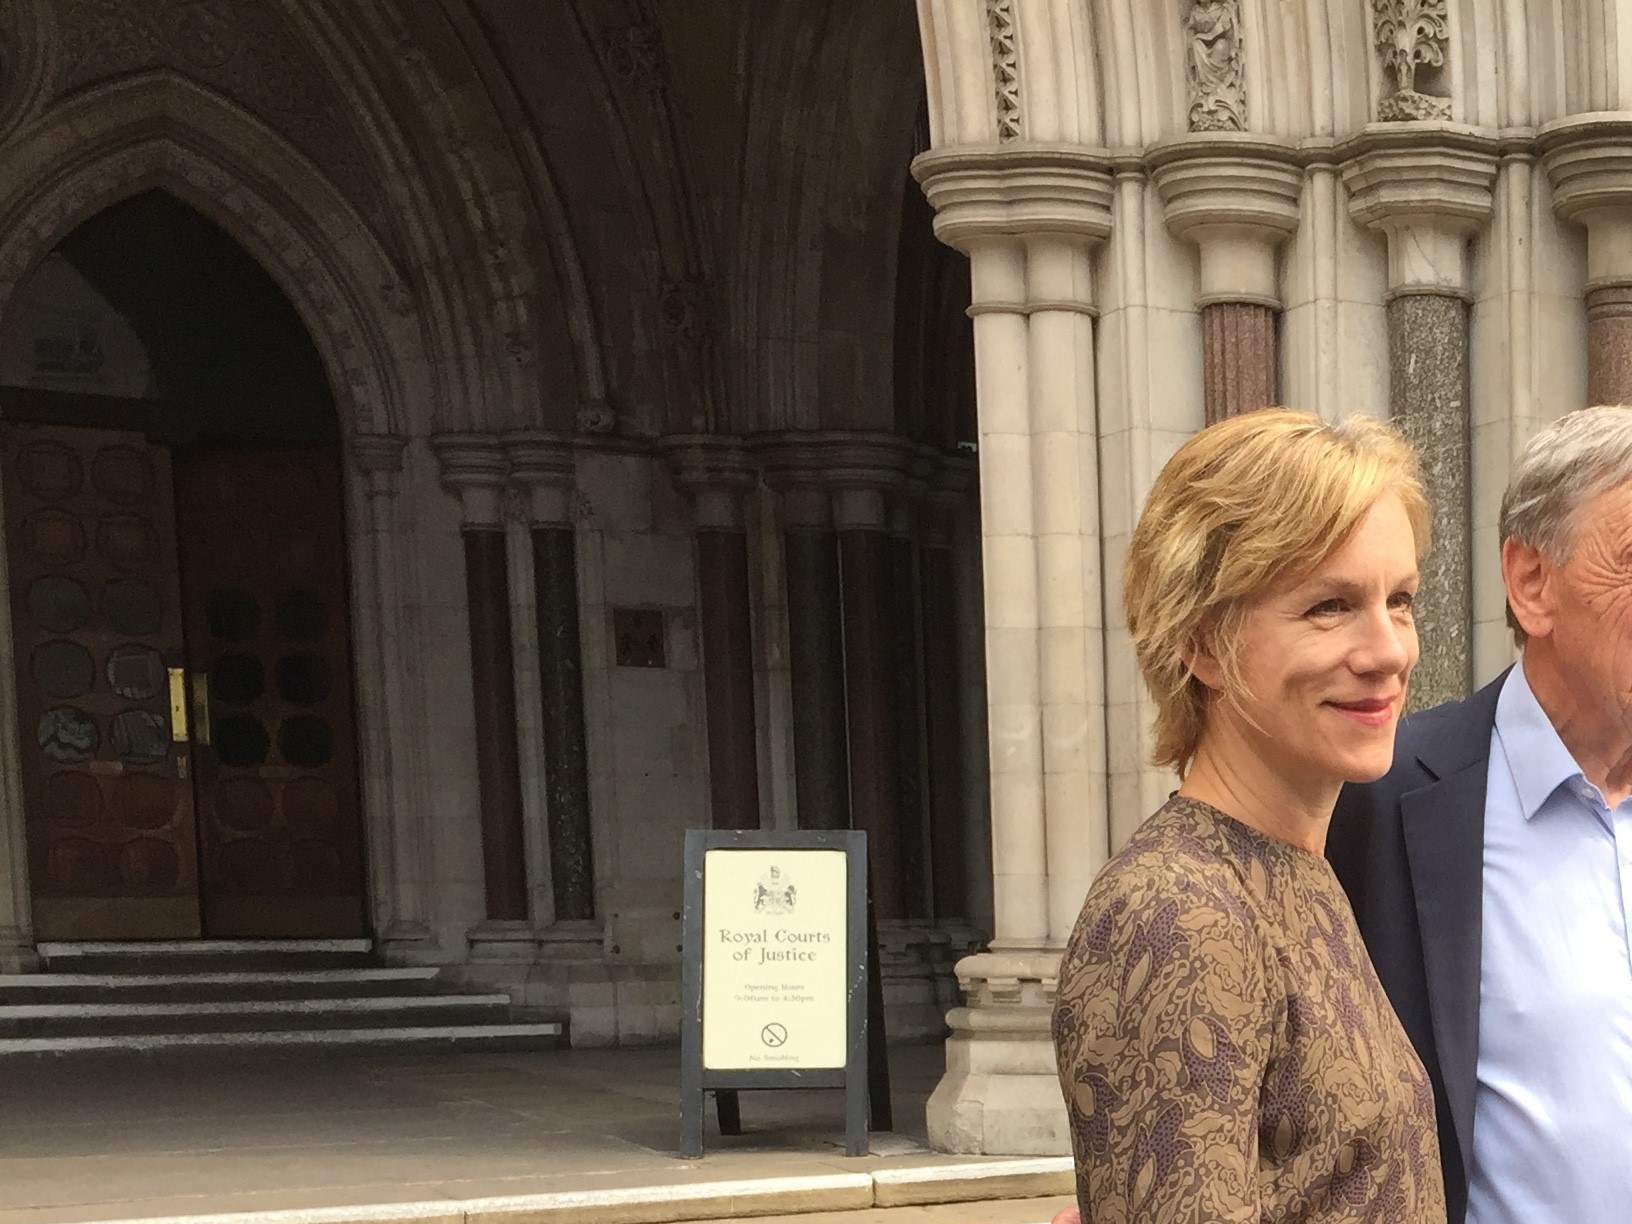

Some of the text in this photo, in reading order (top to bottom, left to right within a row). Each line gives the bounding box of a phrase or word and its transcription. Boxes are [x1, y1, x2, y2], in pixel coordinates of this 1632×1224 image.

[719, 929, 831, 946] Royal Courts
[732, 947, 816, 965] of Justice
[744, 983, 779, 993] Opening
[763, 1055, 800, 1063] Smoking
